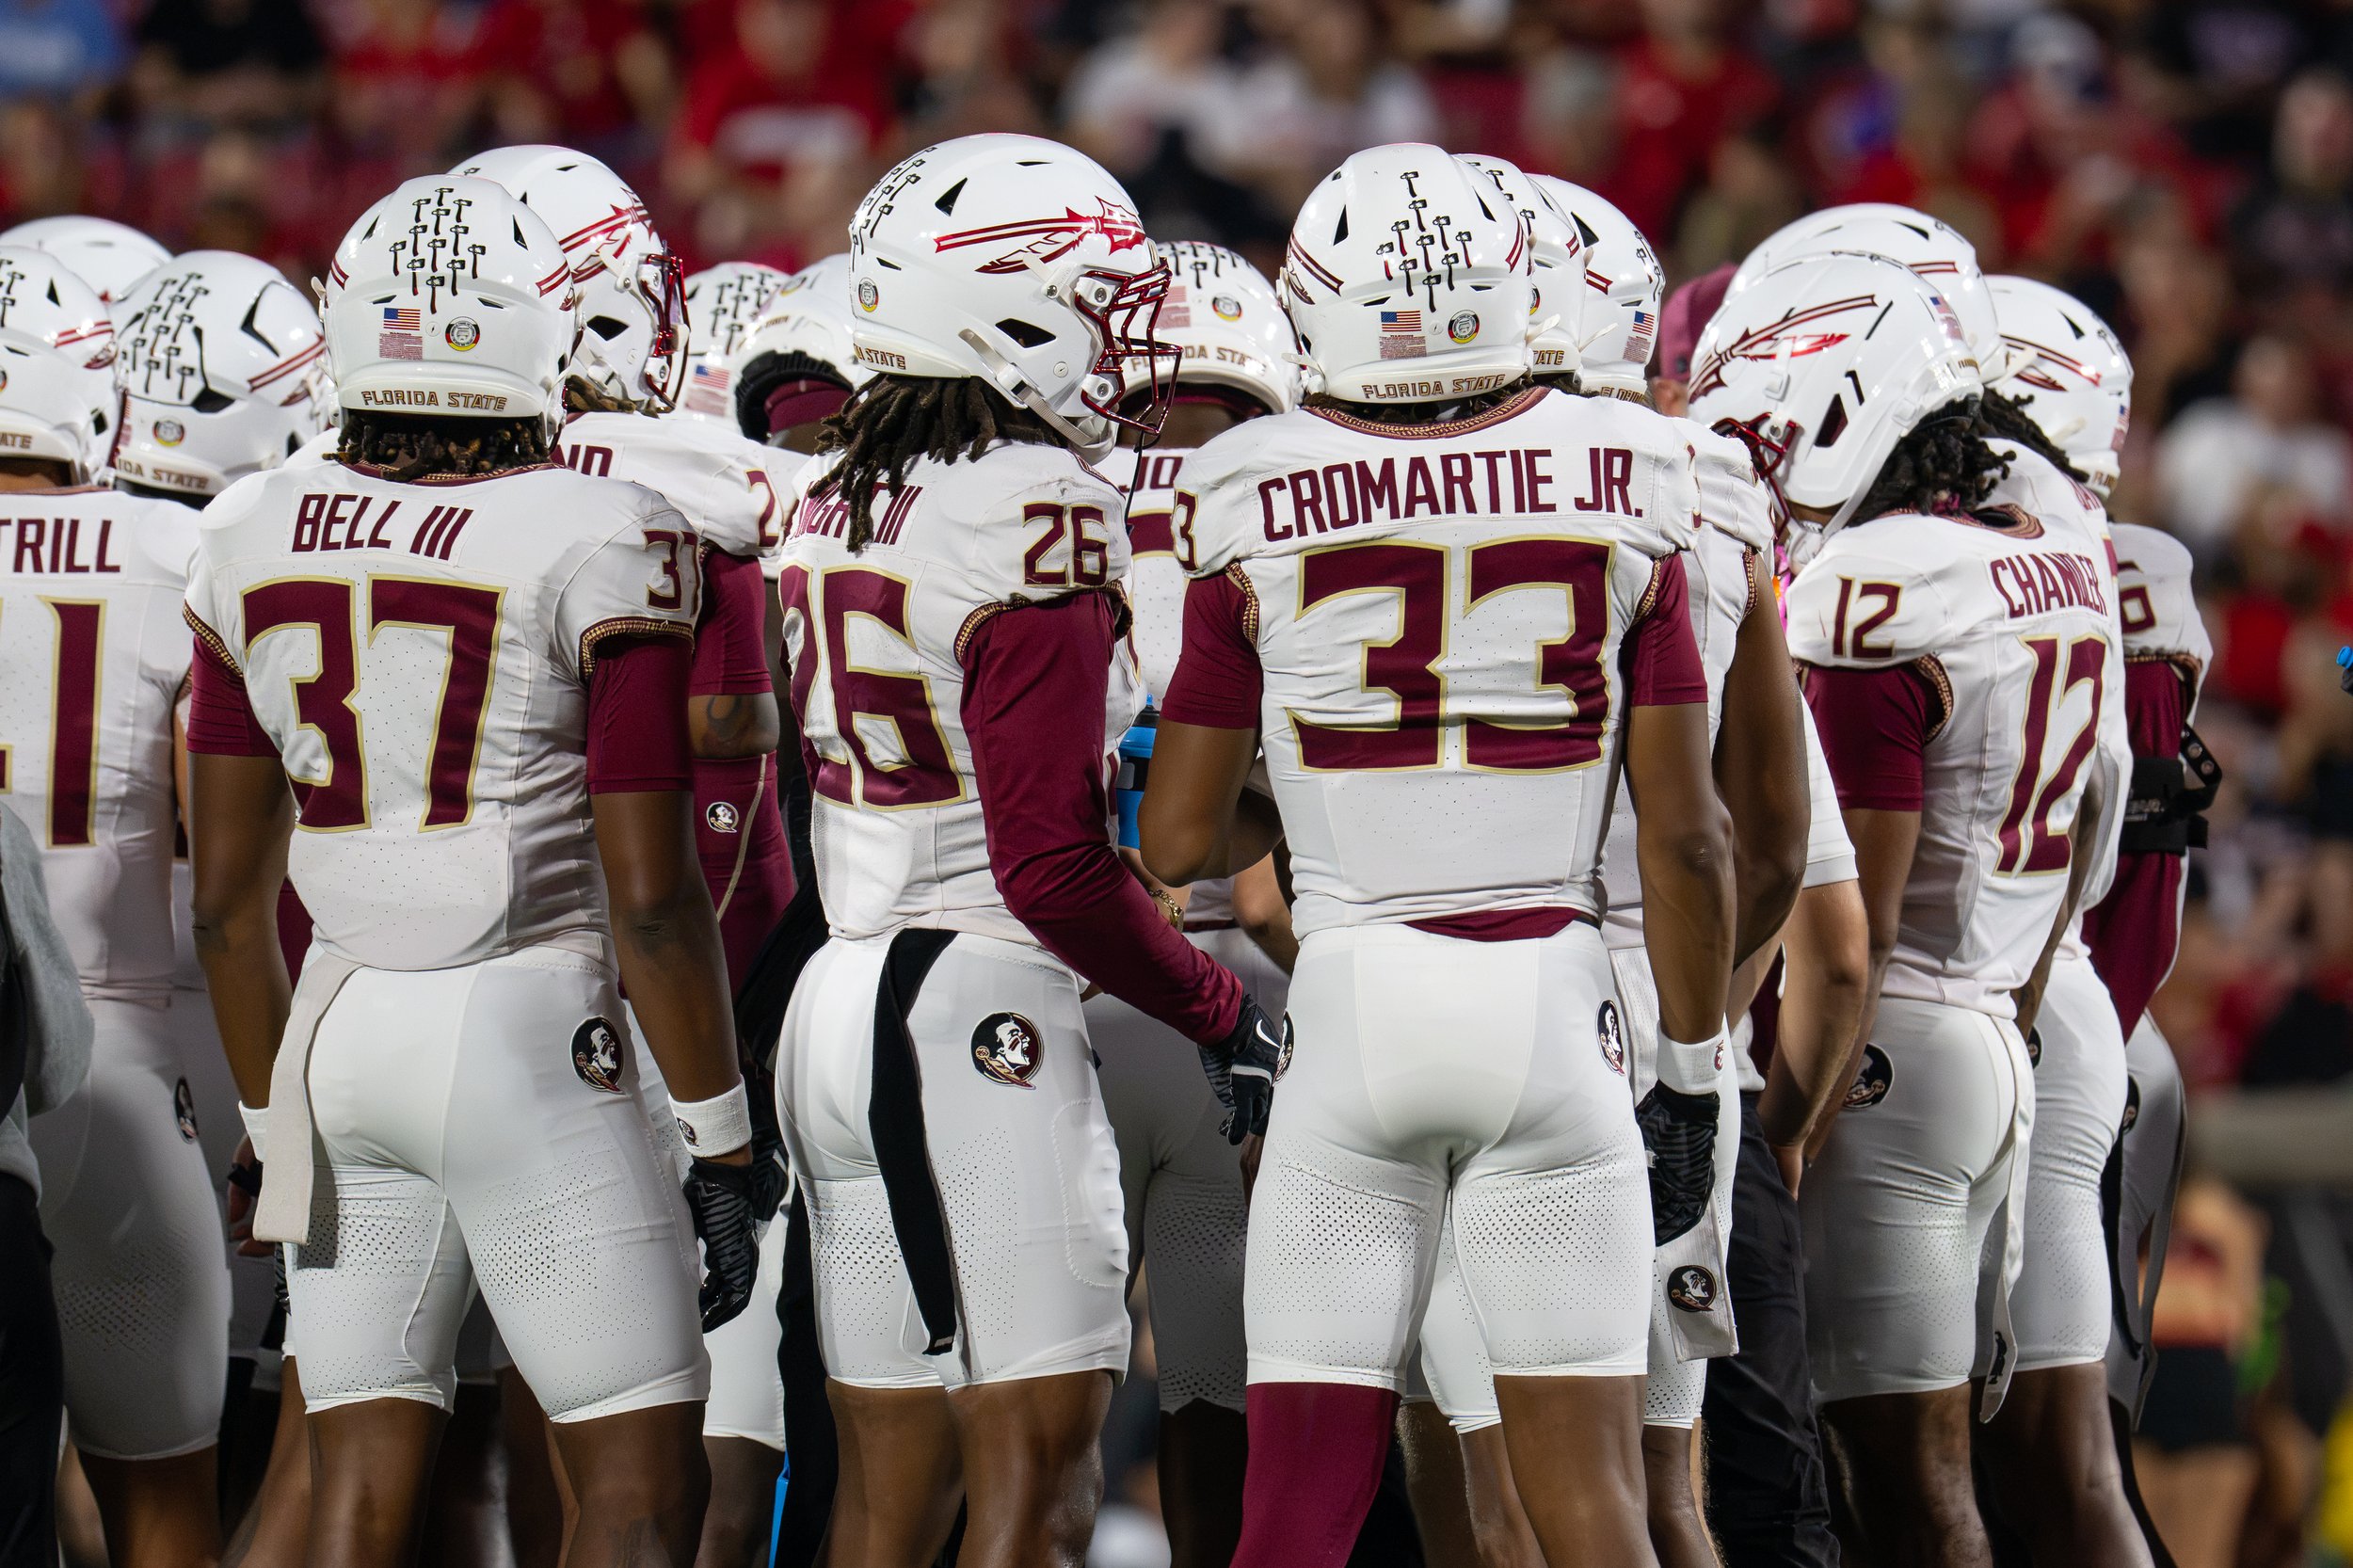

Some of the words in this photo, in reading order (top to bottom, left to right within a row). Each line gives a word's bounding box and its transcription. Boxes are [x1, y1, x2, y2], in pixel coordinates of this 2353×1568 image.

[866, 348, 906, 370] STATE
[1362, 380, 1444, 399] FLORIDA
[1452, 374, 1506, 393] STATE
[1532, 349, 1564, 365] TATE
[361, 390, 439, 406] FLORIDA
[447, 392, 507, 412] STATE
[0, 432, 33, 449] ATE
[152, 466, 209, 489] STATE
[1257, 449, 1556, 543] CROMARTIE
[1575, 447, 1643, 520] JR.
[292, 494, 402, 553] BELL
[410, 504, 472, 561] III
[874, 484, 923, 546] III
[1021, 501, 1109, 589] 26
[643, 529, 698, 616] 37
[1990, 552, 2108, 619] CHANDLER
[1834, 572, 1902, 660] 12
[1281, 535, 1616, 773] 33
[0, 595, 107, 849] 1
[240, 572, 508, 834] 37
[1992, 633, 2107, 879] 12
